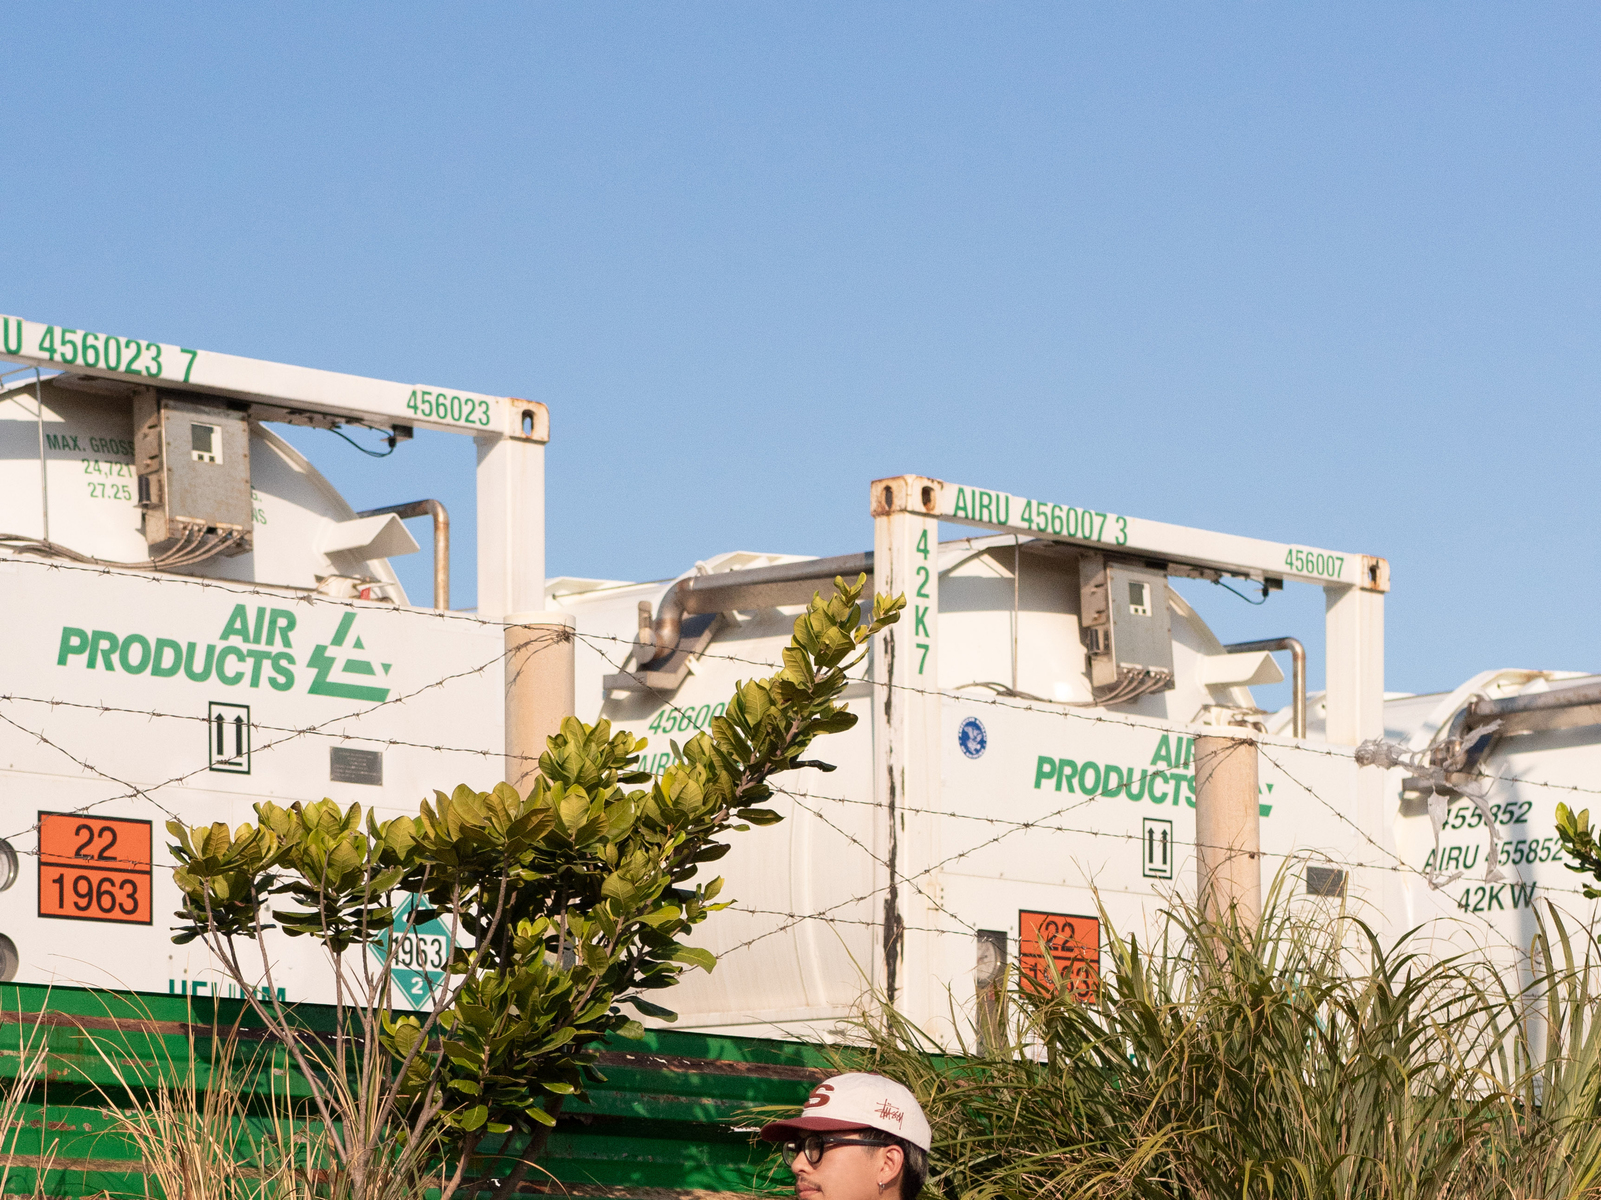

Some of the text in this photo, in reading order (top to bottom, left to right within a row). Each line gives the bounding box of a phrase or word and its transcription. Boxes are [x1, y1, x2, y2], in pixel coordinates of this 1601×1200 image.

[38, 325, 163, 378] 456023
[180, 348, 198, 383] 7
[407, 389, 491, 426] 456023
[46, 434, 87, 452] MAX.
[81, 458, 133, 478] 24,721
[87, 482, 132, 501] 27.25
[953, 487, 1128, 546] AIRU 456007 3
[1285, 548, 1344, 578] 456007
[915, 529, 931, 675] 42K7
[219, 603, 297, 649] AIR
[57, 626, 297, 692] PRODUCTS
[74, 824, 118, 861] 22
[1422, 838, 1563, 873] AIRU 55852
[52, 873, 139, 915] 1963
[1045, 920, 1075, 952] 22
[411, 977, 424, 995] 2
[804, 1083, 835, 1109] S
